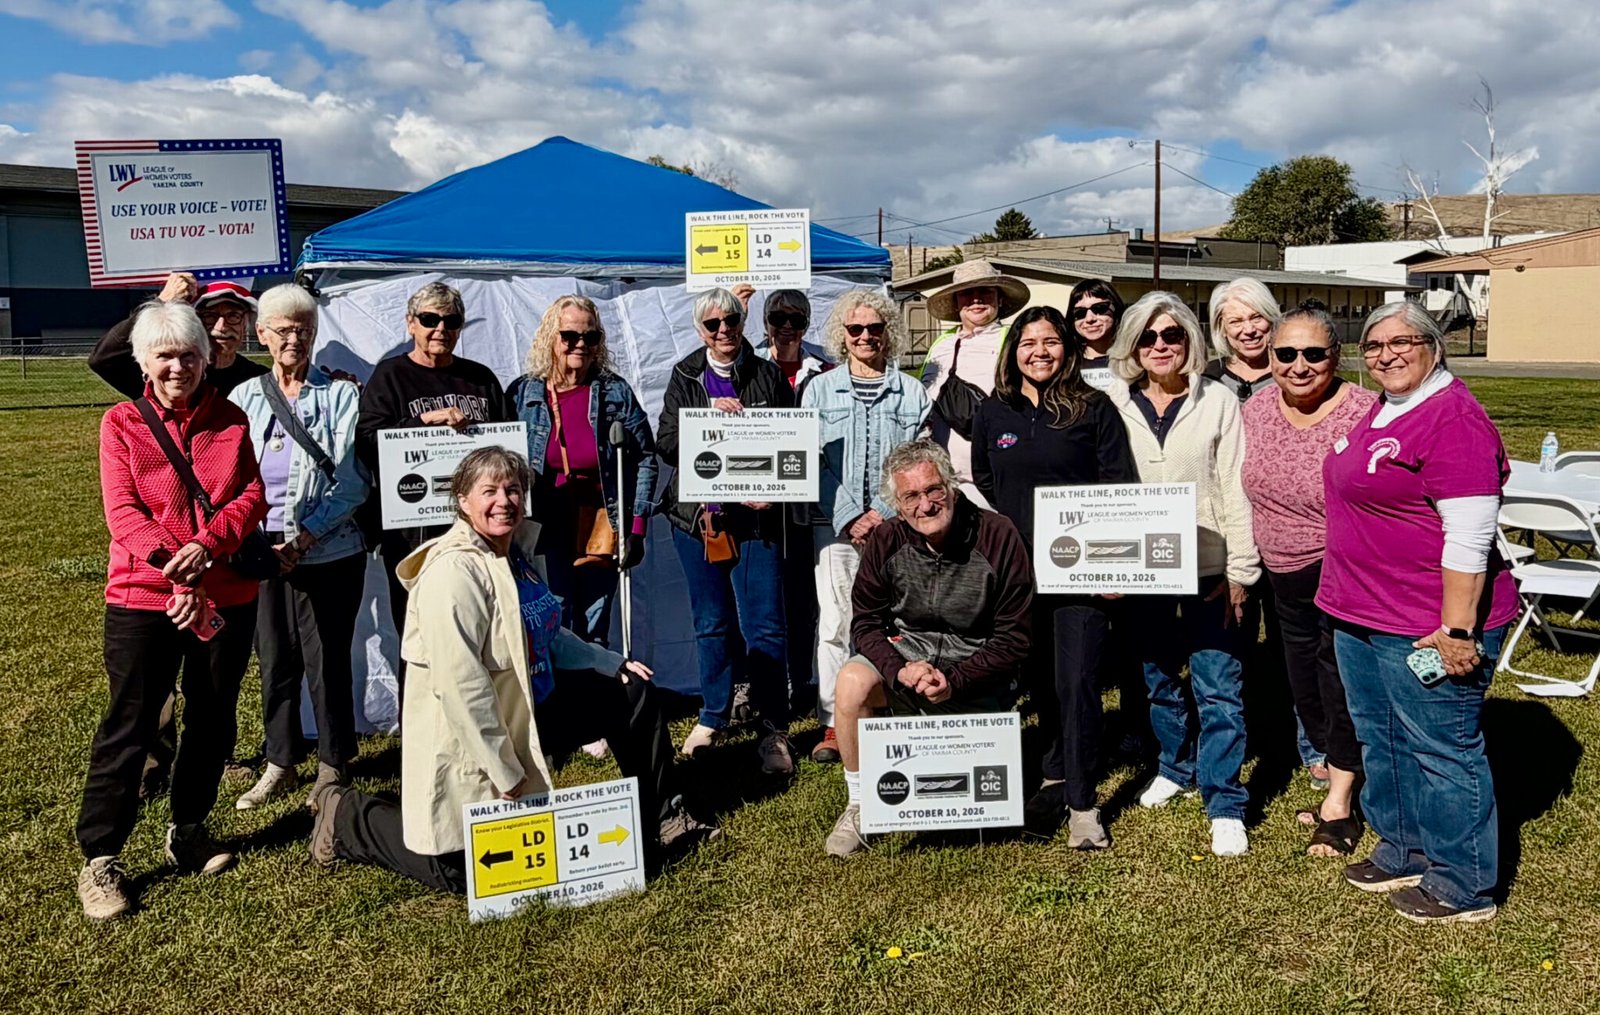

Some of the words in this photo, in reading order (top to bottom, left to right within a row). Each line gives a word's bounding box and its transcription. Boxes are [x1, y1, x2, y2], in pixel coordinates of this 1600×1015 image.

[109, 164, 136, 181] LWV
[112, 205, 137, 217] USE
[140, 203, 176, 216] YOUR
[180, 202, 218, 214] VOICE
[231, 200, 267, 212] VOTE!
[130, 228, 155, 240] USA
[159, 227, 176, 238] TU
[181, 225, 205, 237] VOZ
[219, 223, 254, 235] VOTA!
[725, 235, 740, 245] LD
[756, 235, 771, 243] LD
[726, 250, 740, 259] 15
[757, 249, 771, 258] 14
[445, 394, 489, 421] YORK
[728, 411, 749, 419] LINE,
[385, 432, 410, 440] WALK
[456, 427, 478, 435] ROCK
[481, 426, 497, 434] THE
[500, 425, 521, 433] VOTE
[703, 430, 725, 441] LWV
[405, 450, 428, 463] LWV
[753, 484, 764, 492] 10,
[1041, 491, 1066, 499] WALK
[1088, 490, 1112, 498] LINE,
[1059, 511, 1084, 525] LWV
[1152, 550, 1173, 558] OIC
[1117, 574, 1130, 583] 10,
[521, 593, 556, 616] REGISTE
[526, 614, 541, 630] TO
[865, 723, 892, 731] WALK
[895, 722, 912, 730] THE
[915, 721, 940, 730] LINE,
[942, 720, 968, 728] ROCK
[990, 718, 1014, 726] VOTE
[886, 744, 912, 759] LWV
[879, 782, 908, 790] NAACP
[981, 782, 1001, 791] OIC
[470, 803, 500, 817] WALK
[504, 801, 523, 811] THE
[525, 797, 552, 807] LINE,
[555, 791, 583, 804] ROCK
[585, 787, 604, 798] THE
[607, 783, 632, 794] VOTE
[899, 810, 943, 818] OCTOBER
[946, 809, 960, 818] 10,
[963, 807, 984, 815] 2026
[567, 823, 588, 839] LD
[522, 831, 545, 847] LD
[569, 845, 589, 861] 14
[525, 853, 546, 869] 15
[512, 890, 560, 906] OCTOBER
[563, 887, 578, 897] 10,
[581, 881, 604, 893] 2026
